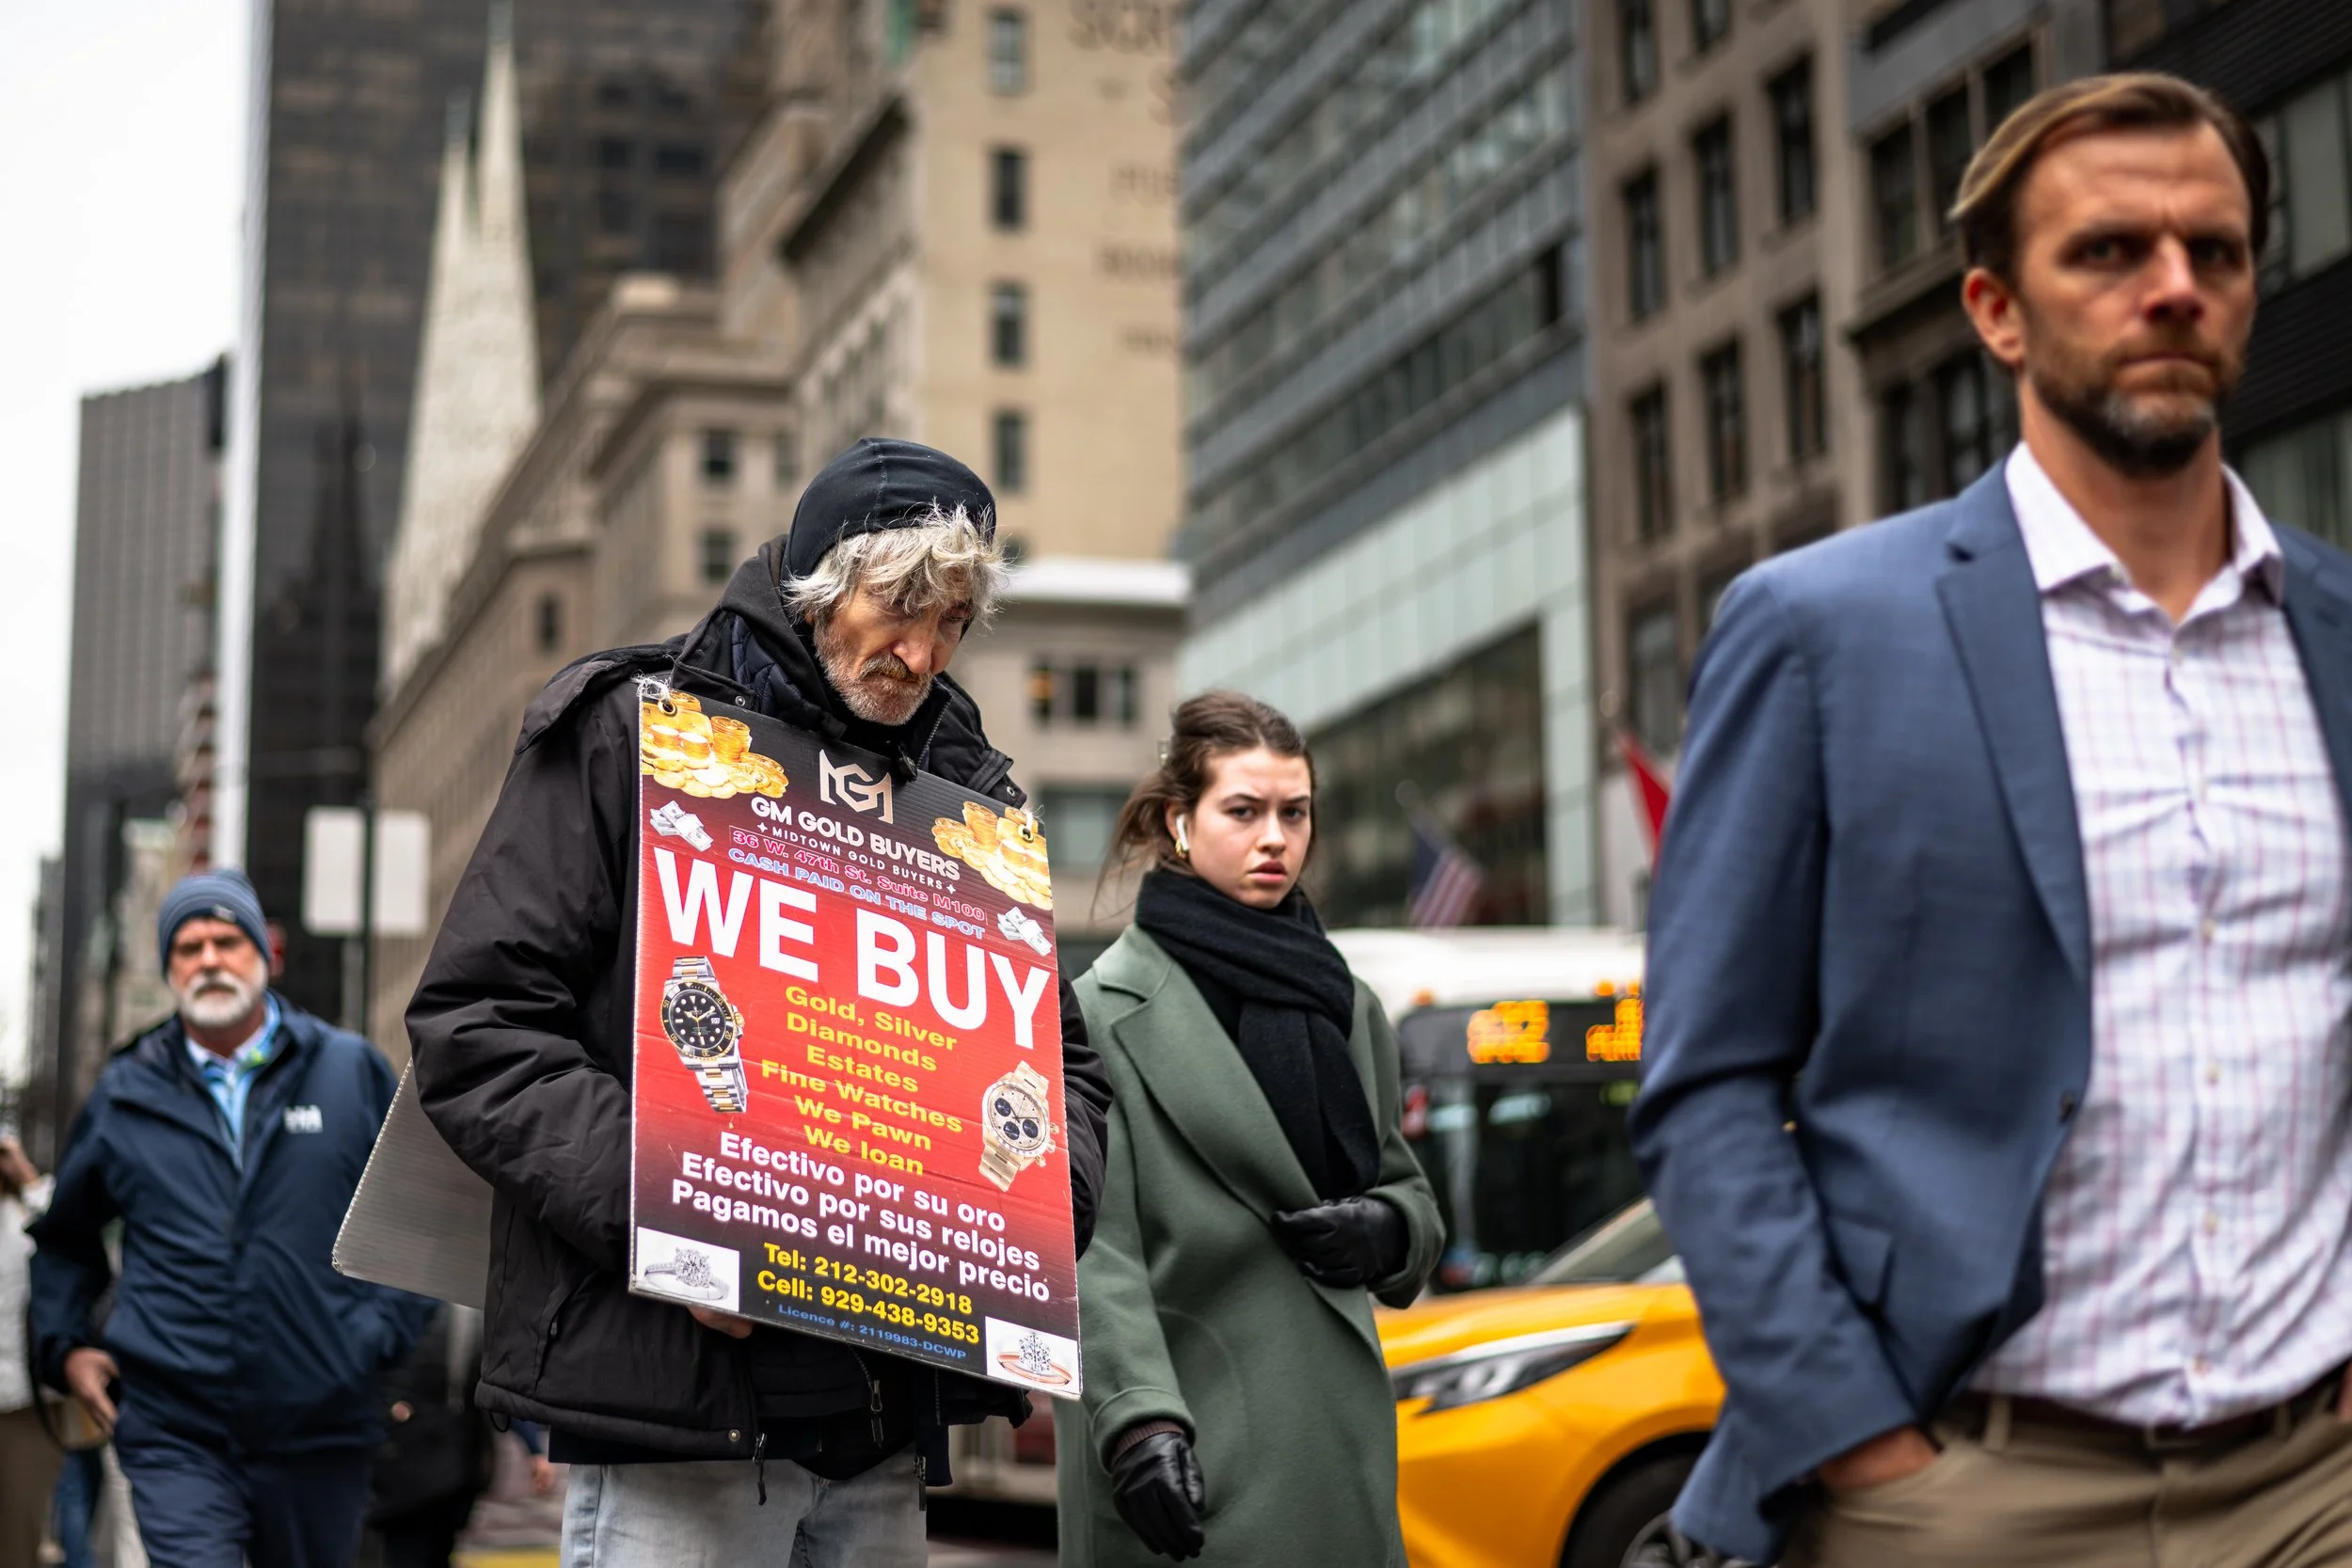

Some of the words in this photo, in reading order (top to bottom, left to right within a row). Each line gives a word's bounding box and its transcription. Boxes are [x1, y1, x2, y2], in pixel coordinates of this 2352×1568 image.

[751, 797, 792, 825] GM
[798, 811, 864, 847] GOLD
[870, 832, 960, 880] BUYERS
[772, 826, 841, 856] MIDTOWN
[849, 850, 885, 870] GOLD
[893, 865, 942, 890] BUYERS
[728, 848, 788, 877] CASH
[795, 866, 844, 892] PAID
[850, 884, 881, 905] ON
[885, 895, 928, 921] THE
[932, 911, 985, 939] SPOT
[733, 831, 758, 848] 36
[763, 839, 788, 858] W.
[794, 850, 839, 874] 47th
[845, 864, 871, 884] St.
[878, 876, 928, 902] Suite
[933, 894, 984, 920] M100
[654, 847, 818, 982] WE
[856, 908, 1050, 1051] BUY
[786, 986, 864, 1025] Gold,
[875, 1011, 957, 1052] Silver
[787, 1012, 937, 1072] Diamonds
[761, 1058, 826, 1094] Fine
[834, 1079, 962, 1133] Watches
[806, 1046, 918, 1093] Estates
[794, 1095, 842, 1125] We
[852, 1112, 931, 1151] Pawn
[803, 1125, 851, 1155] We
[861, 1142, 923, 1176] loan
[681, 1151, 809, 1206] Efectivo
[819, 1190, 869, 1222] por
[880, 1210, 931, 1240] sus
[942, 1227, 1040, 1271] relojes
[720, 1132, 845, 1187] Efectivo
[855, 1173, 904, 1201] por
[914, 1189, 948, 1217] su
[958, 1203, 1005, 1231] oro
[673, 1180, 818, 1238] Pagamos
[828, 1222, 854, 1249] el
[865, 1234, 950, 1273] mejor
[960, 1259, 1050, 1303] precio
[757, 1270, 813, 1301] Cell:
[820, 1286, 979, 1343] 929-438-9353
[764, 1243, 806, 1271] Tel:
[814, 1256, 972, 1314] 212-302-2918
[778, 1304, 834, 1326] Licence
[839, 1320, 854, 1331] #:
[859, 1324, 967, 1359] 2119983-DCWP
